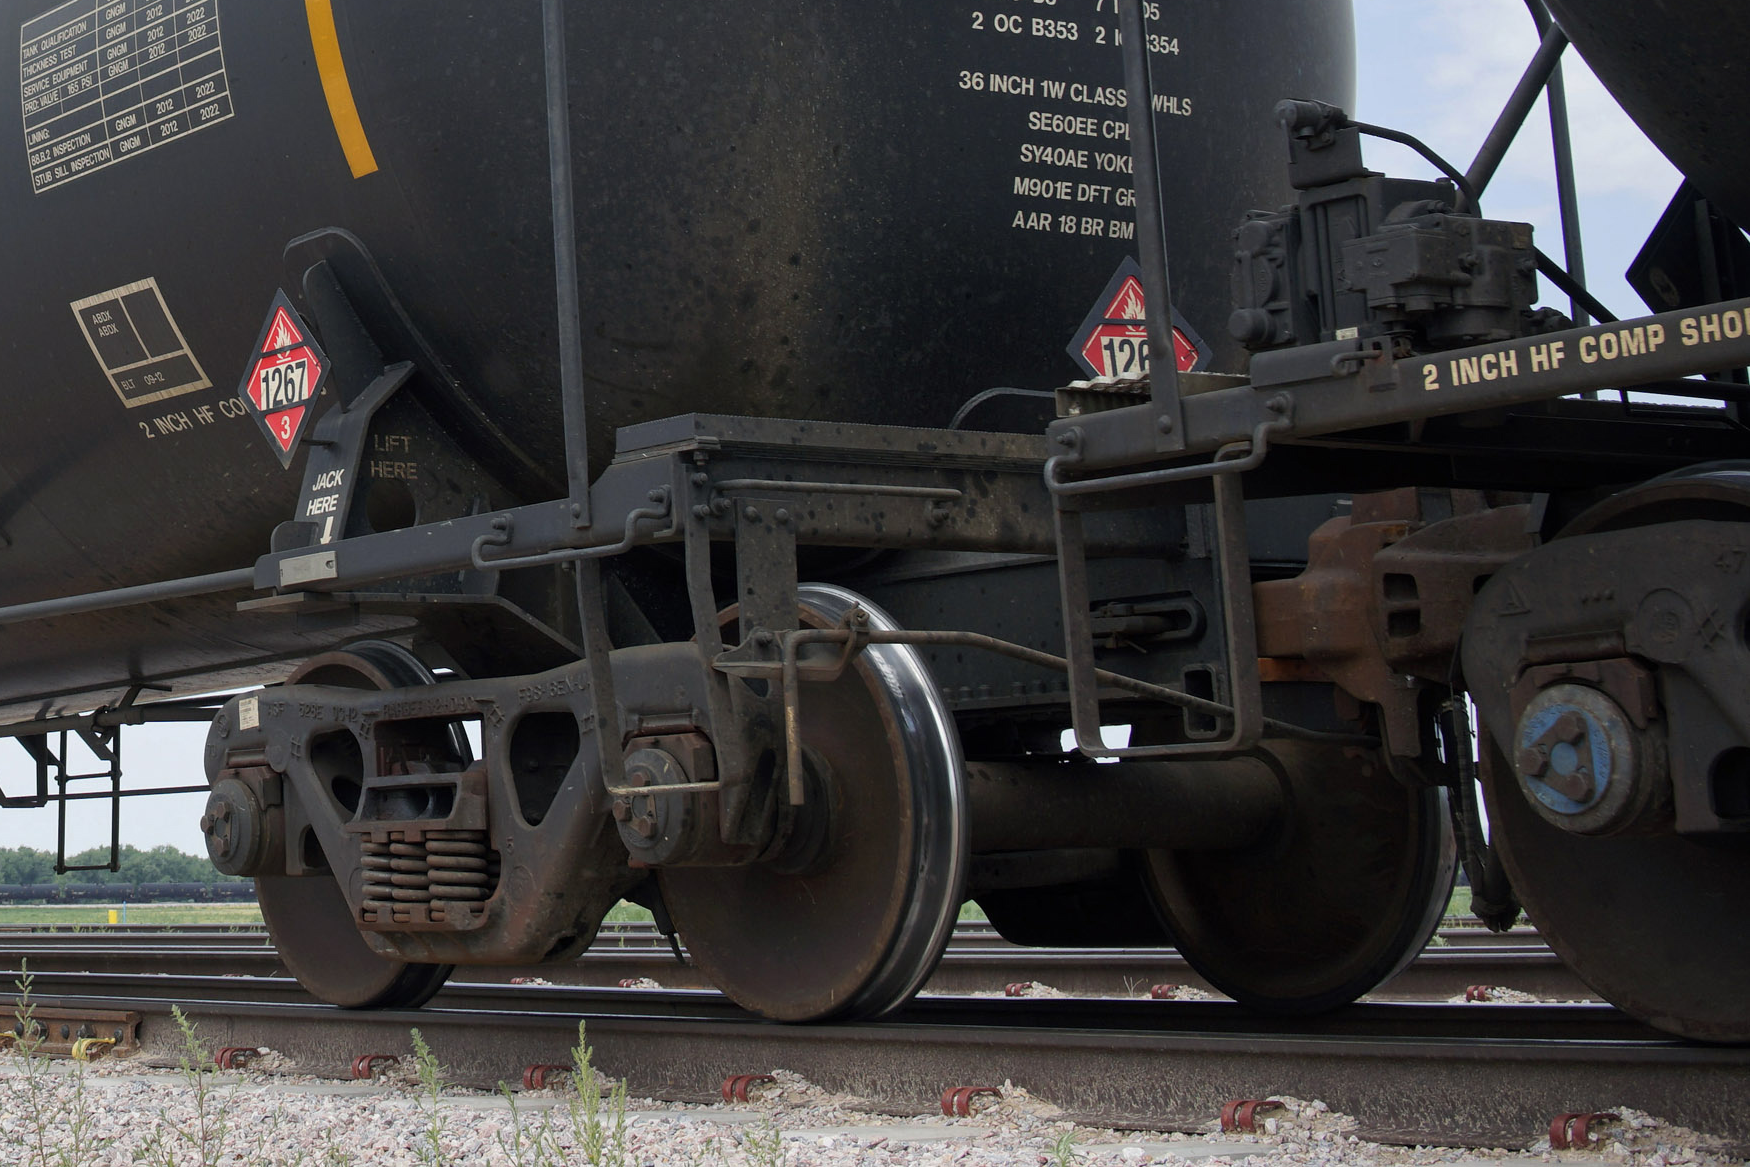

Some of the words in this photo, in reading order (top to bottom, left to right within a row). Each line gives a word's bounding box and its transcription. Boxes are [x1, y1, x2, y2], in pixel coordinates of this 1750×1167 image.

[23, 44, 39, 59] TANK
[41, 22, 87, 51] QUALIFICATION
[106, 3, 126, 20] GNGM
[23, 56, 58, 78] THICKNESS
[60, 45, 76, 61] TEST
[106, 22, 126, 39] GNGM
[146, 5, 163, 21] 2012
[971, 11, 984, 30] 2
[994, 13, 1023, 34] OC
[1031, 17, 1079, 41] B353
[1095, 26, 1106, 44] 2
[1114, 28, 1123, 46] I
[24, 79, 50, 98] SERVICE
[52, 60, 88, 84] EQUIPMENT
[107, 42, 127, 60] GNGM
[147, 26, 164, 42] 2012
[186, 7, 205, 24] 2022
[40, 91, 59, 108] VALVE
[67, 81, 79, 95] 165
[81, 76, 93, 92] PSI
[108, 60, 129, 77] GNGM
[149, 43, 165, 59] 2012
[188, 25, 207, 41] 2022
[958, 70, 984, 91] 36
[989, 73, 1034, 96] INCH
[1040, 79, 1065, 99] 1W
[1070, 83, 1127, 108] CLASS
[1153, 94, 1192, 116] WHLS
[28, 128, 50, 145] LINING:
[52, 133, 91, 157] INSPECTION
[115, 114, 137, 132] GNGM
[156, 99, 174, 115] 2012
[196, 81, 215, 98] 2022
[1028, 111, 1097, 137] SE60EE
[1102, 120, 1131, 141] CPL
[35, 173, 52, 187] STUB
[55, 166, 69, 179] SILL
[70, 147, 110, 173] INSPECTION
[119, 135, 141, 153] GNGM
[160, 120, 178, 136] 2012
[200, 103, 220, 121] 2022
[1020, 143, 1088, 169] SY40AE
[1013, 177, 1072, 201] M901E
[1077, 183, 1111, 206] DFT
[1012, 210, 1052, 232] AAR
[1058, 214, 1076, 234] 18
[1081, 217, 1104, 237] BR
[1109, 220, 1134, 240] BM
[1103, 338, 1149, 377] 126
[1422, 364, 1439, 391] 2
[1450, 349, 1519, 386] INCH
[1529, 341, 1565, 373] HF
[1579, 323, 1666, 364] COMP
[262, 360, 306, 409] 1267
[139, 421, 155, 439] 2
[153, 411, 193, 435] INCH
[193, 405, 215, 425] HF
[219, 397, 250, 418] CO
[280, 415, 291, 439] 3
[375, 434, 412, 452] LIFT
[312, 468, 345, 491] JACK
[370, 460, 418, 479] HERE
[306, 494, 339, 516] HERE
